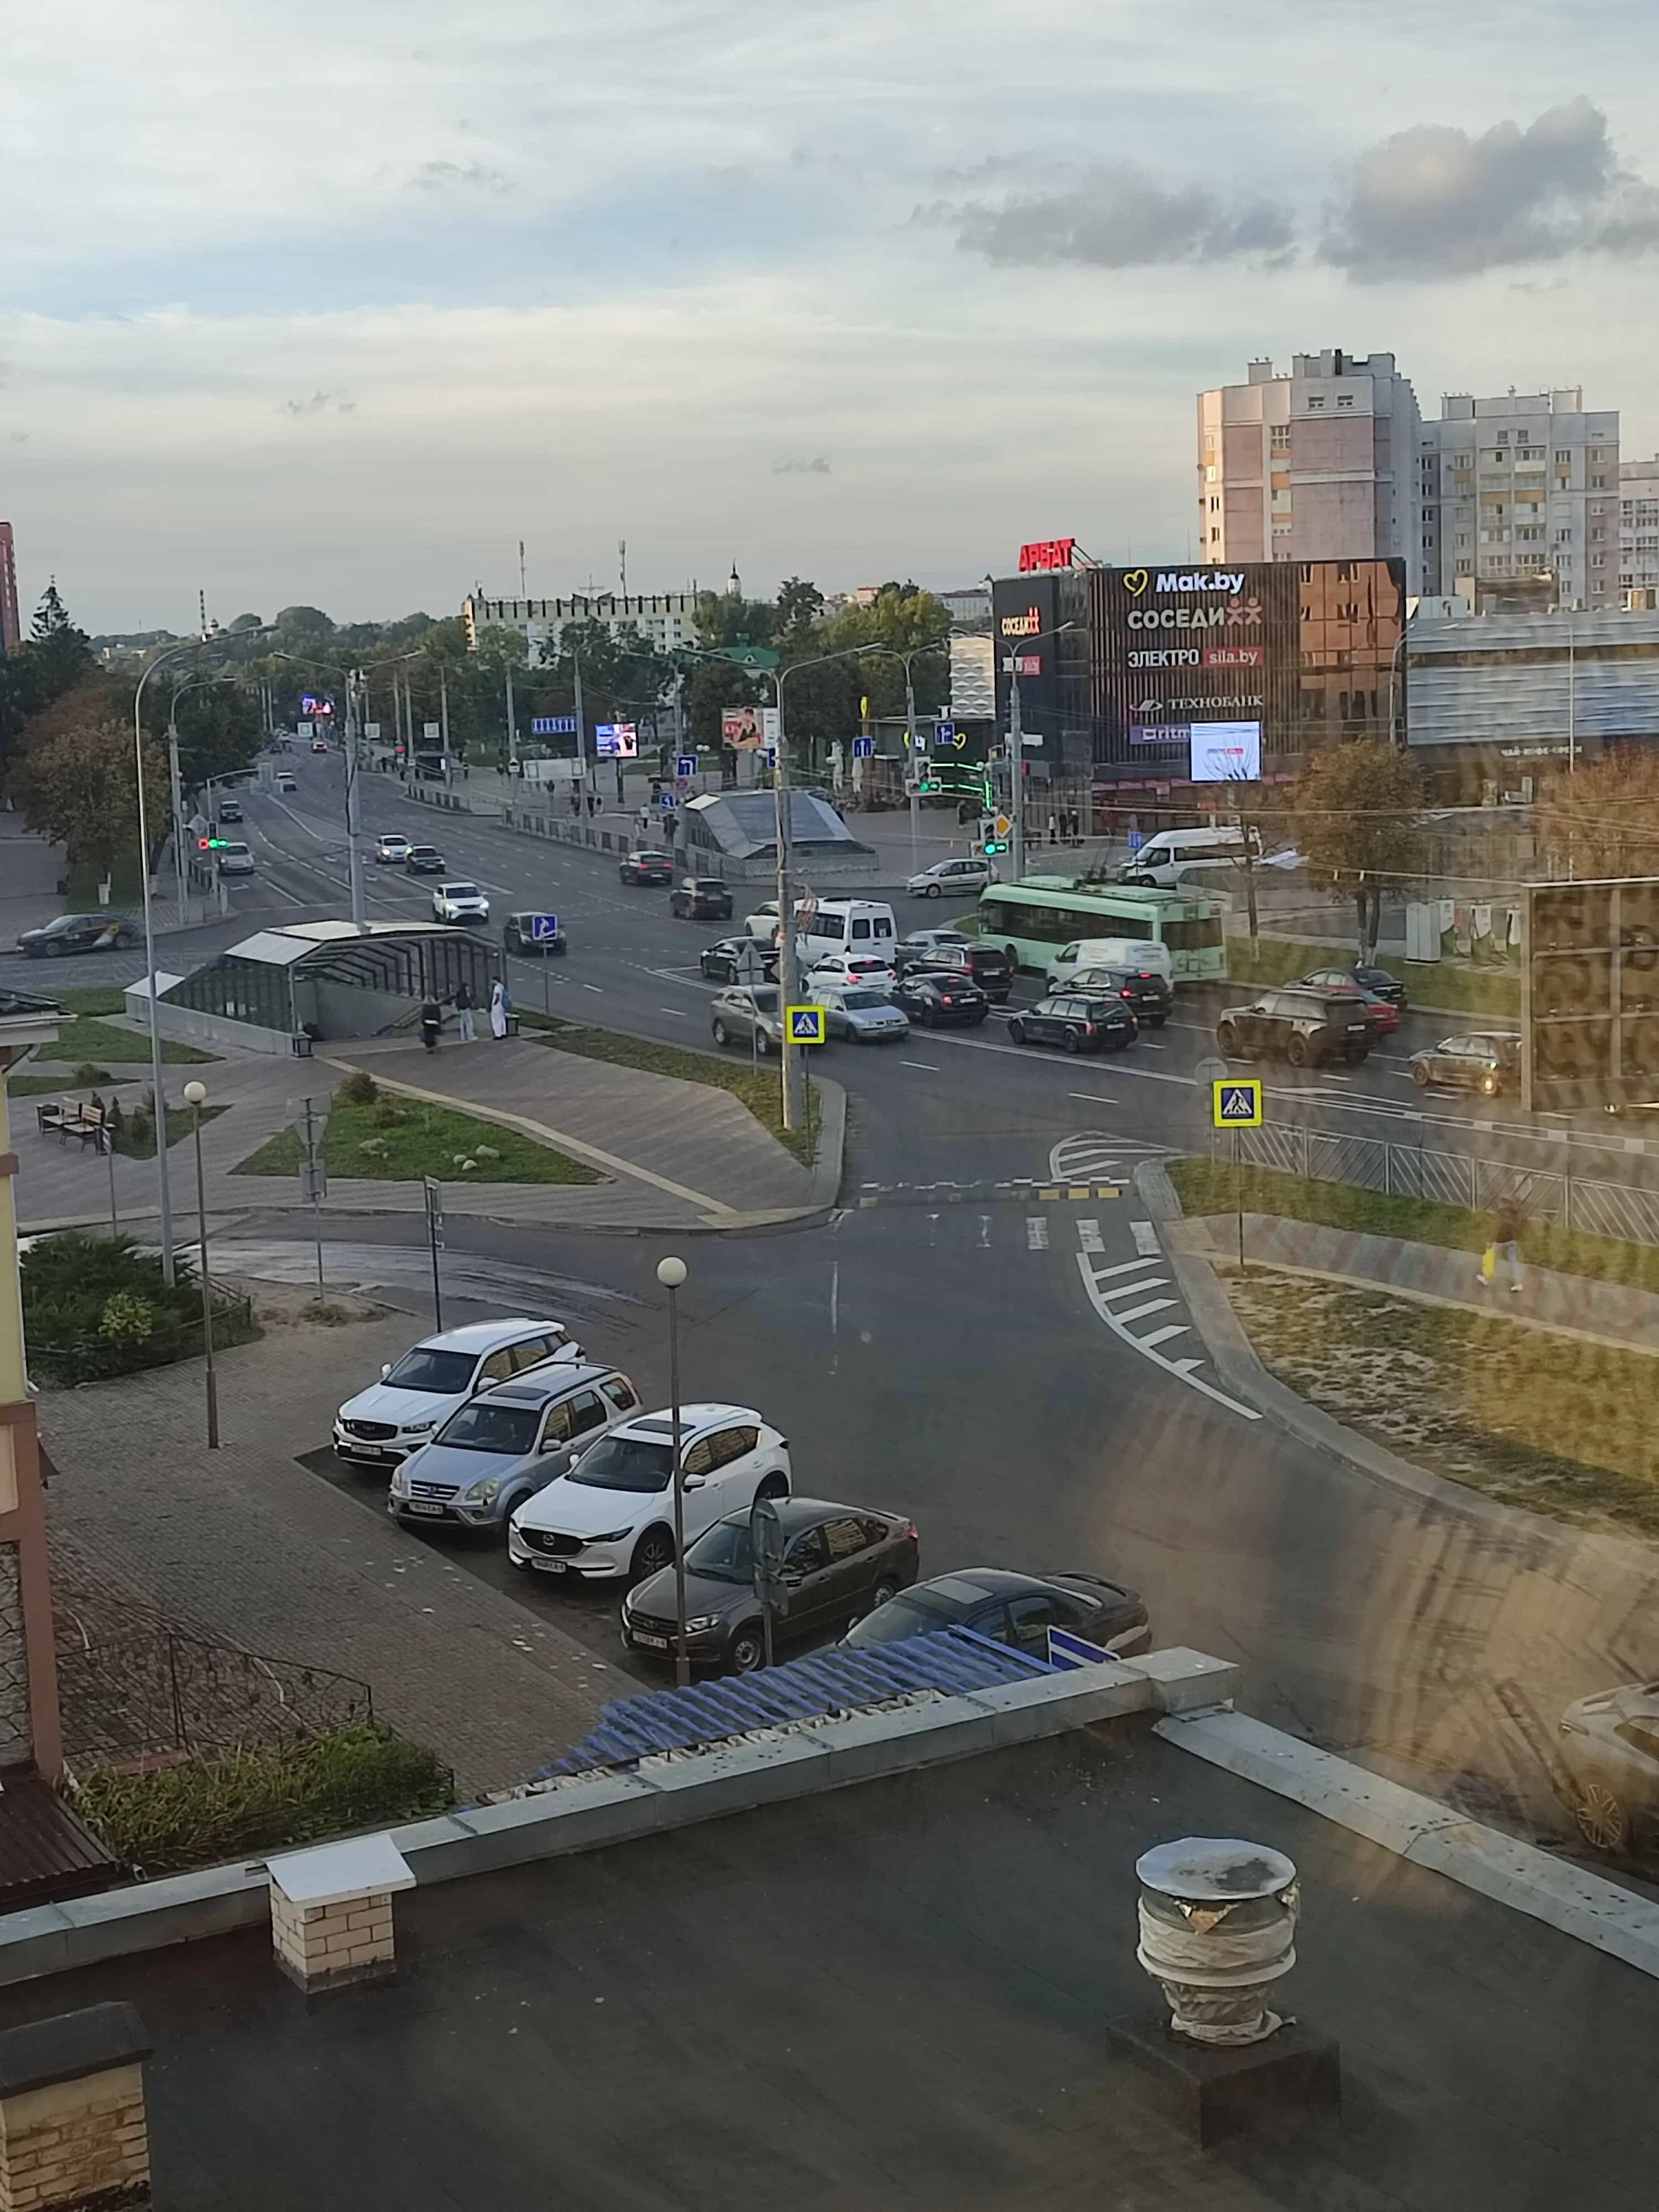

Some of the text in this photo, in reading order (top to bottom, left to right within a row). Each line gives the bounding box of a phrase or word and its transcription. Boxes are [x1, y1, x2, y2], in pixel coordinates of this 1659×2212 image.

[1019, 539, 1074, 571] АРБАТ
[1128, 607, 1224, 629] СОСЕДИ
[1128, 649, 1199, 667] ЭЛЕКТРО
[1209, 649, 1258, 665] sila.by
[1168, 695, 1263, 709] ТЕХНОБАНК
